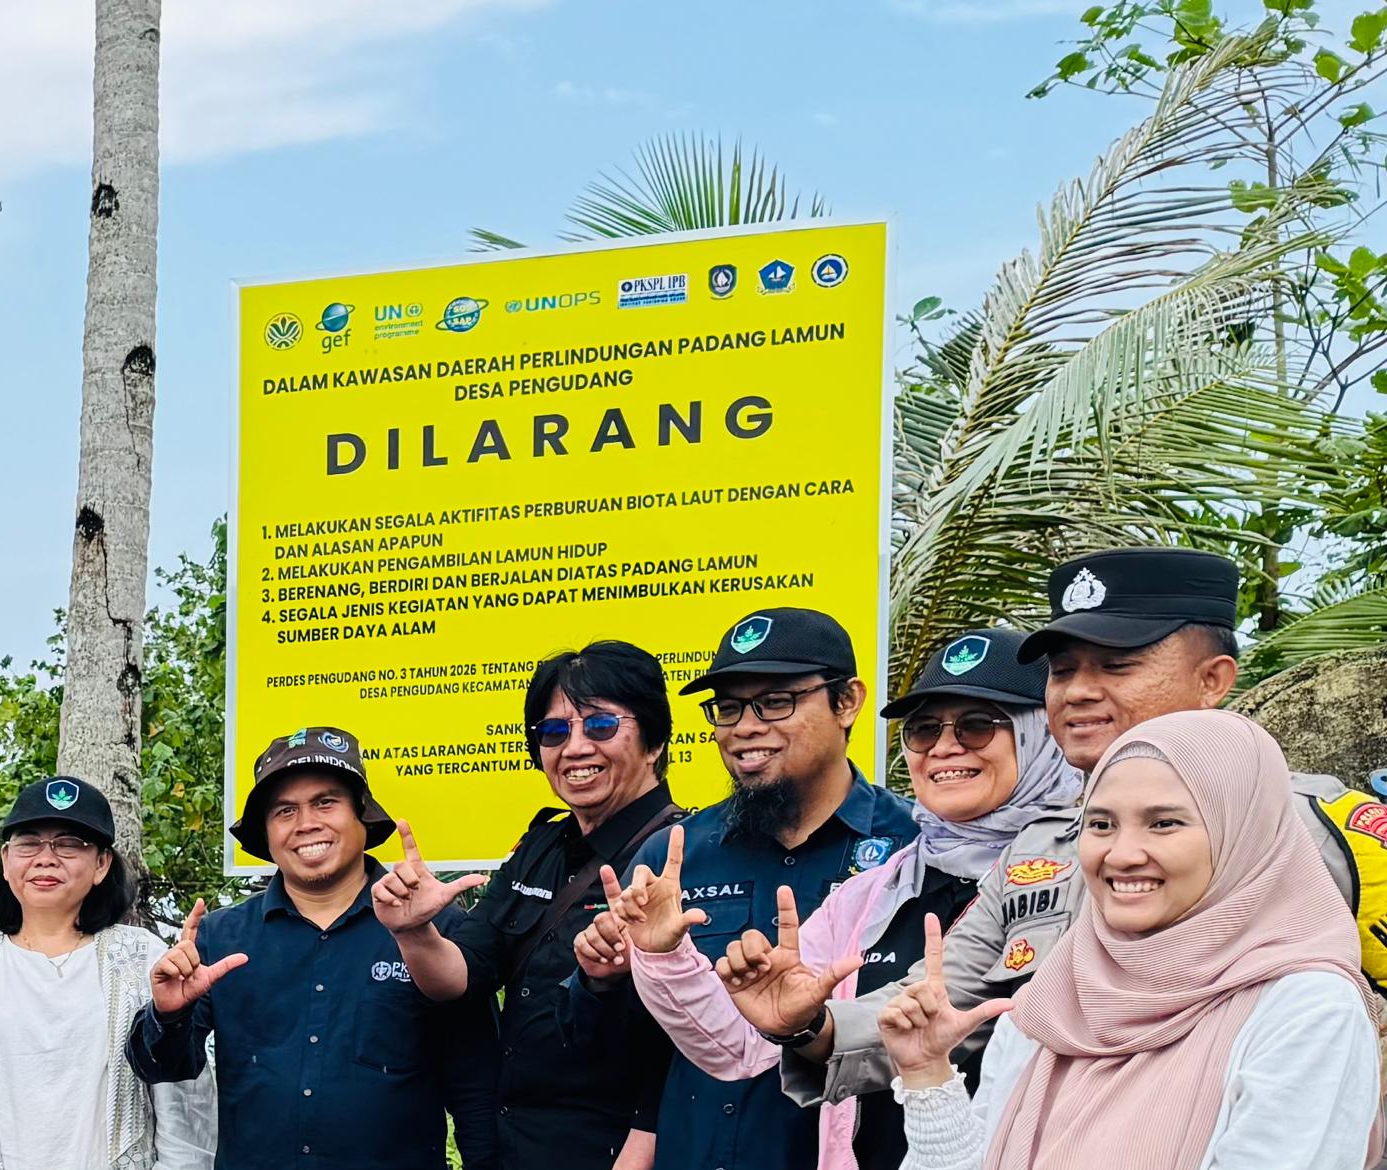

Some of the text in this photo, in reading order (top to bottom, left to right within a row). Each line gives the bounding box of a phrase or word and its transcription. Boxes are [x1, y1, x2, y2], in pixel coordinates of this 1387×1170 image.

[668, 274, 686, 289] IPB
[374, 303, 402, 321] UN
[526, 291, 601, 311] UNOPS
[374, 320, 423, 331] environment
[374, 330, 420, 341] programme
[322, 329, 352, 354] gef
[263, 322, 845, 396] DALAM KAWASAN DAERAH PERLINDUNGAN PADANG LAMUN
[454, 369, 634, 402] DESA PENGUDANG
[326, 395, 773, 476] DILARANG
[261, 479, 855, 540] 1. MELAKUKAN SEGALA AKTIFITAS PERBURUAN BIOTA LAUT DENGAN CARA
[274, 532, 443, 560] DAN ALASAN APAPUN
[261, 542, 608, 582] 2. MELAKUKAN PENGAMBILAN LAMUN HIDUP
[261, 554, 758, 603] 3. BERENANG, BERDIRI DAN BERJALAN DIATAS PADANG LAMUN
[261, 572, 814, 624] 4. SEGALA JENIS KEGIATAN YANG DAPAT MENIMBULKAN KERUSAKAN
[277, 620, 436, 644] SUMBER DAYA ALAM
[266, 674, 306, 688] PERDES
[307, 670, 376, 686] PENGUDANG
[378, 669, 398, 681] NO.
[400, 667, 407, 680] 3
[409, 666, 448, 680] TAHUN
[481, 660, 534, 676] TENTANG
[359, 686, 388, 700] DESA
[390, 682, 460, 698] PENGUDANG
[383, 746, 419, 760] ATAS
[421, 742, 497, 758] LARANGAN
[395, 763, 434, 777] YANG
[436, 759, 521, 775] TERCANTUM
[679, 750, 695, 764] 13
